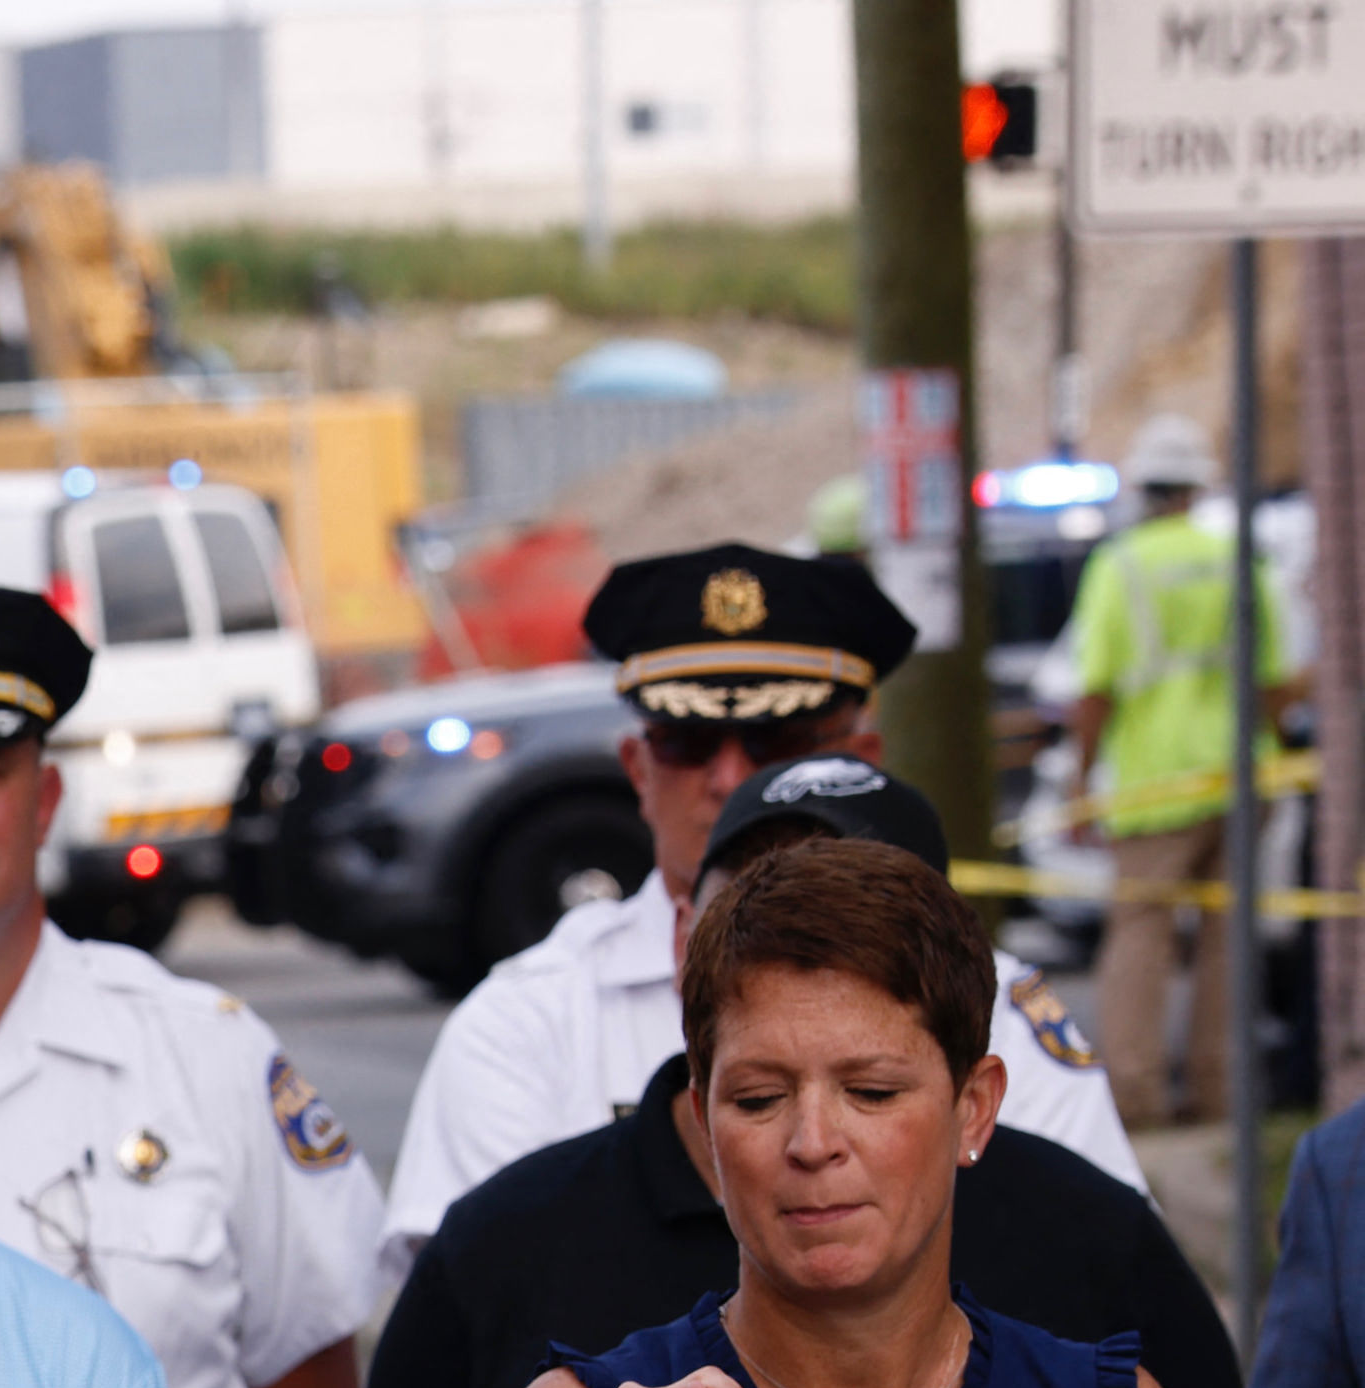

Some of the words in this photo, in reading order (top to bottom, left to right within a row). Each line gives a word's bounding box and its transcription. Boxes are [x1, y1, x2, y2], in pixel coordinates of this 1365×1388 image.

[1159, 2, 1331, 80] MUST
[1101, 116, 1235, 182] TURN
[1248, 112, 1365, 180] RIGH
